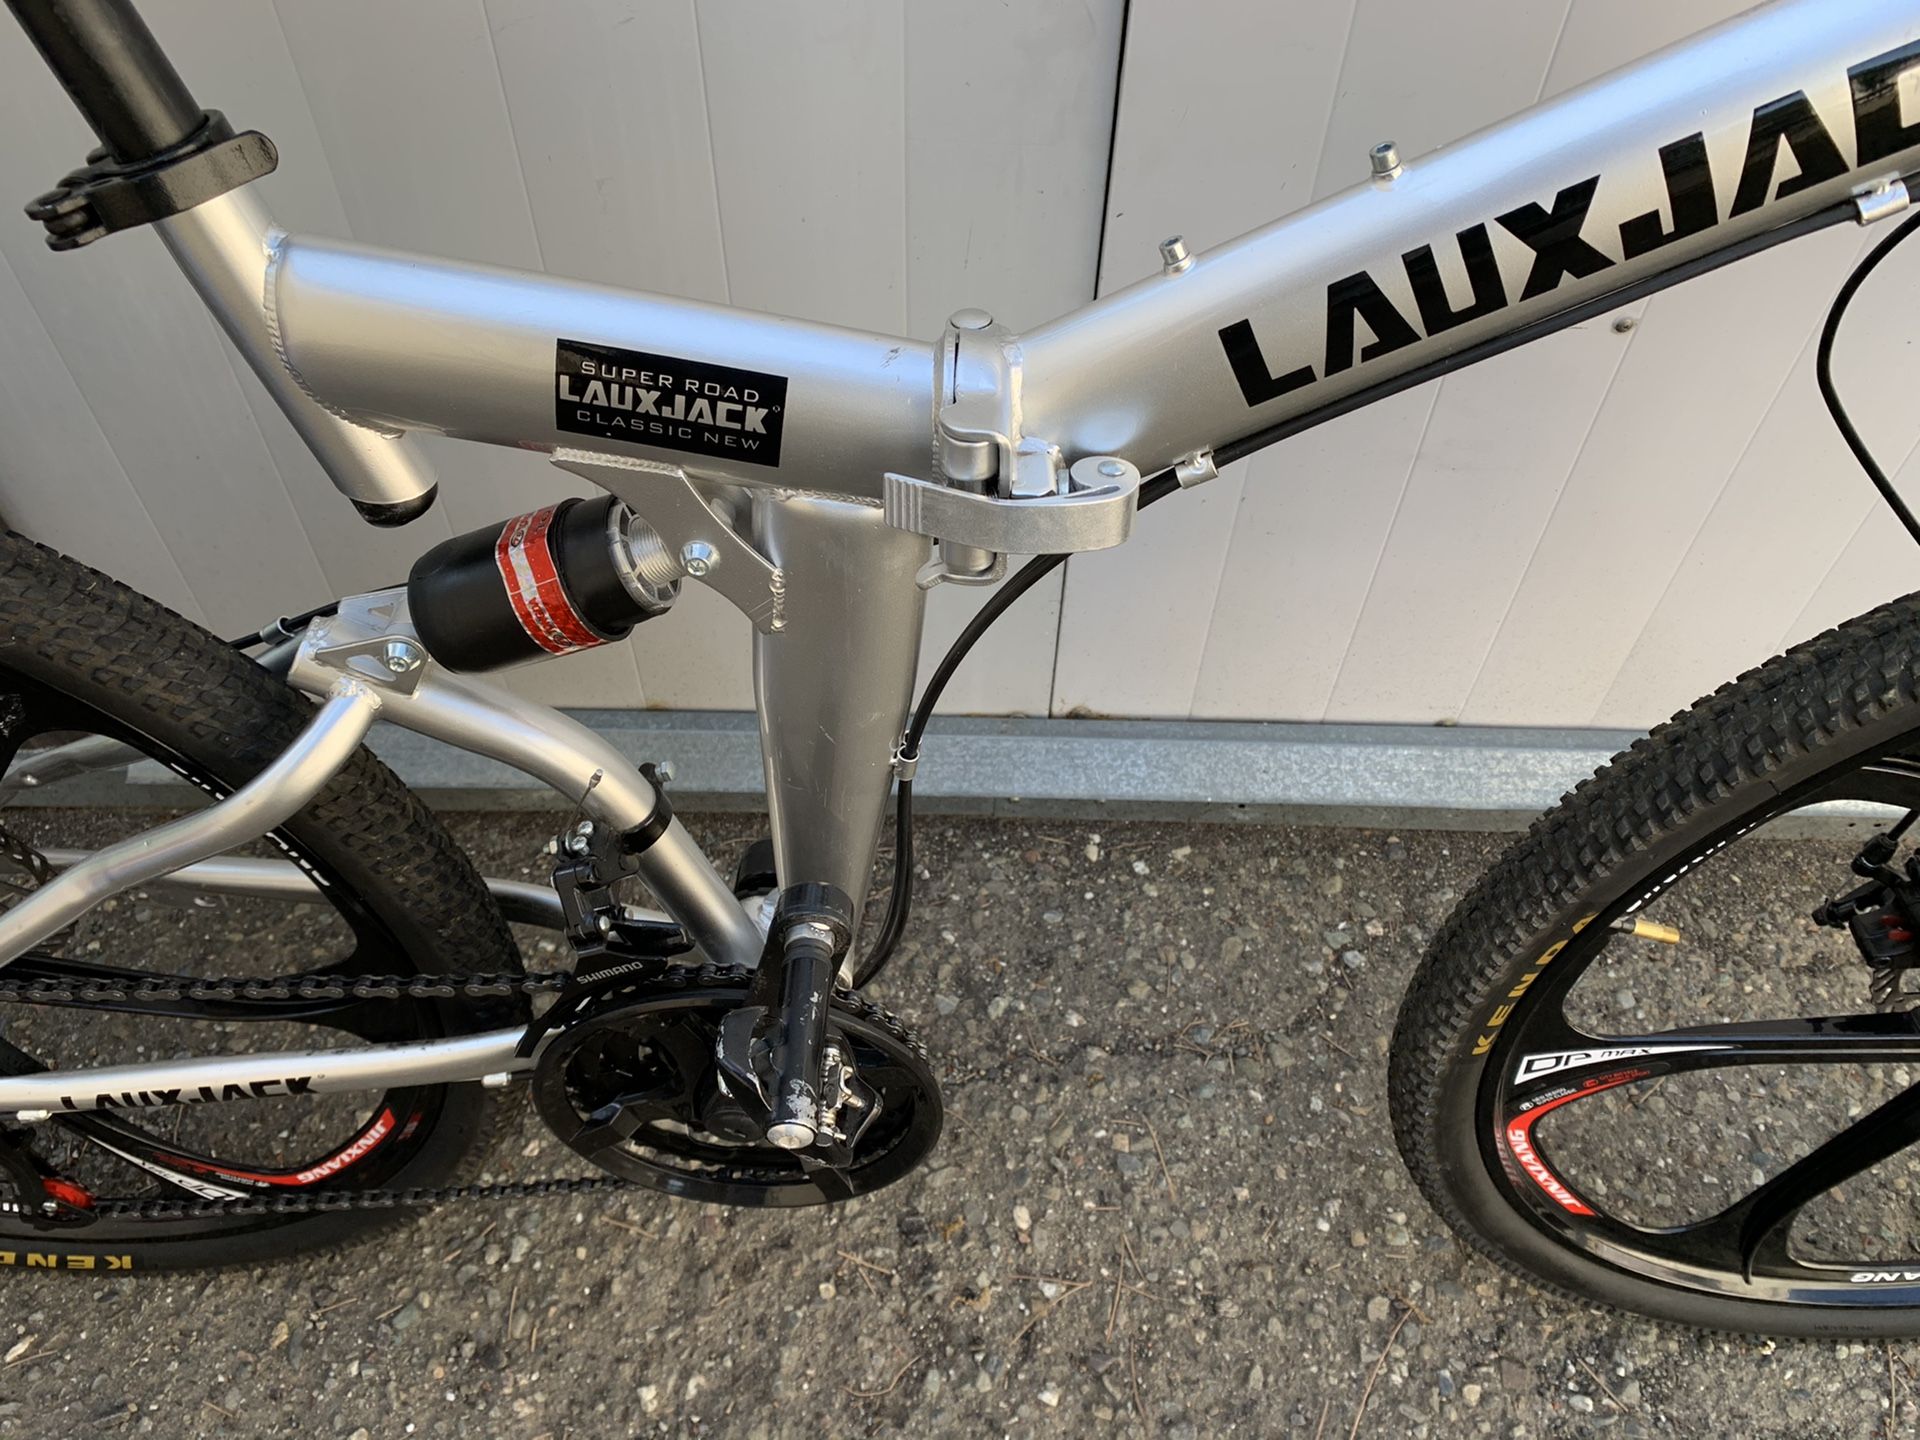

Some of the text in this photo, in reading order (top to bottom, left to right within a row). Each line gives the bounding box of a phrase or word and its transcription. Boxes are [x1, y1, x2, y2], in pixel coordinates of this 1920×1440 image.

[559, 374, 769, 434] LAUXJACK
[581, 361, 760, 402] SUPER ROAD
[576, 410, 760, 450] CLASSIC NEW
[576, 961, 643, 984] SHIMANO
[295, 1119, 386, 1184] JINXIANG
[1509, 1128, 1582, 1208] JINXIANG
